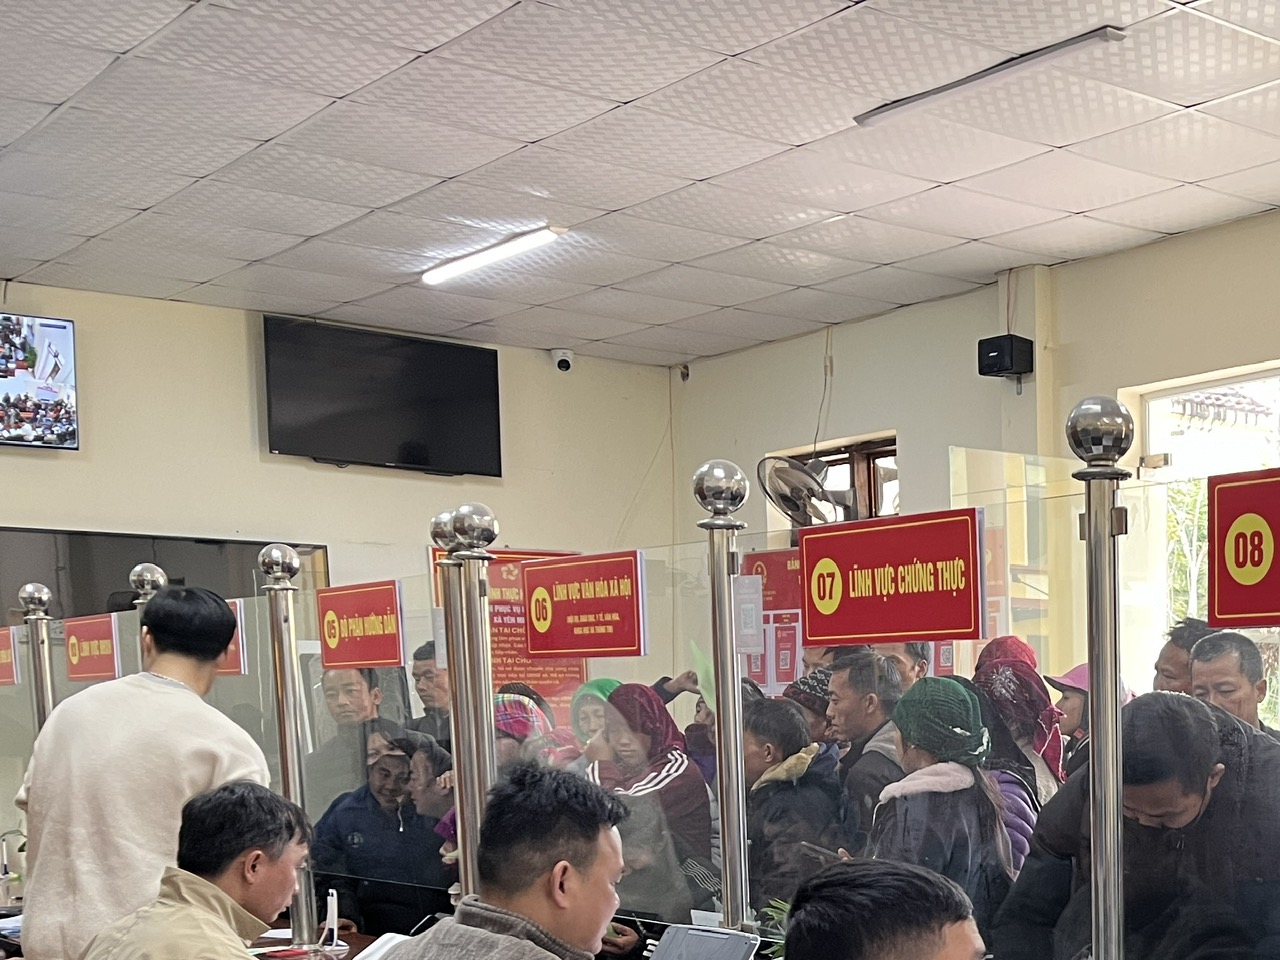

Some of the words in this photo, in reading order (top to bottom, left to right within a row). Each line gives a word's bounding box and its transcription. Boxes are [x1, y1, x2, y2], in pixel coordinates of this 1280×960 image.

[1234, 530, 1264, 569] 08
[553, 581, 568, 601] LĨNH
[568, 581, 581, 604] VỰC
[581, 578, 594, 599] VĂN
[619, 574, 632, 600] HỘI
[817, 572, 836, 601] 07
[849, 563, 873, 598] LĨNH
[874, 563, 895, 602] VỰC
[898, 557, 935, 594] CHỨNG
[936, 556, 965, 597] THỰC
[535, 597, 548, 622] 06
[326, 619, 336, 639] 05
[339, 614, 349, 642] BỘ
[349, 613, 364, 641] PHẬN
